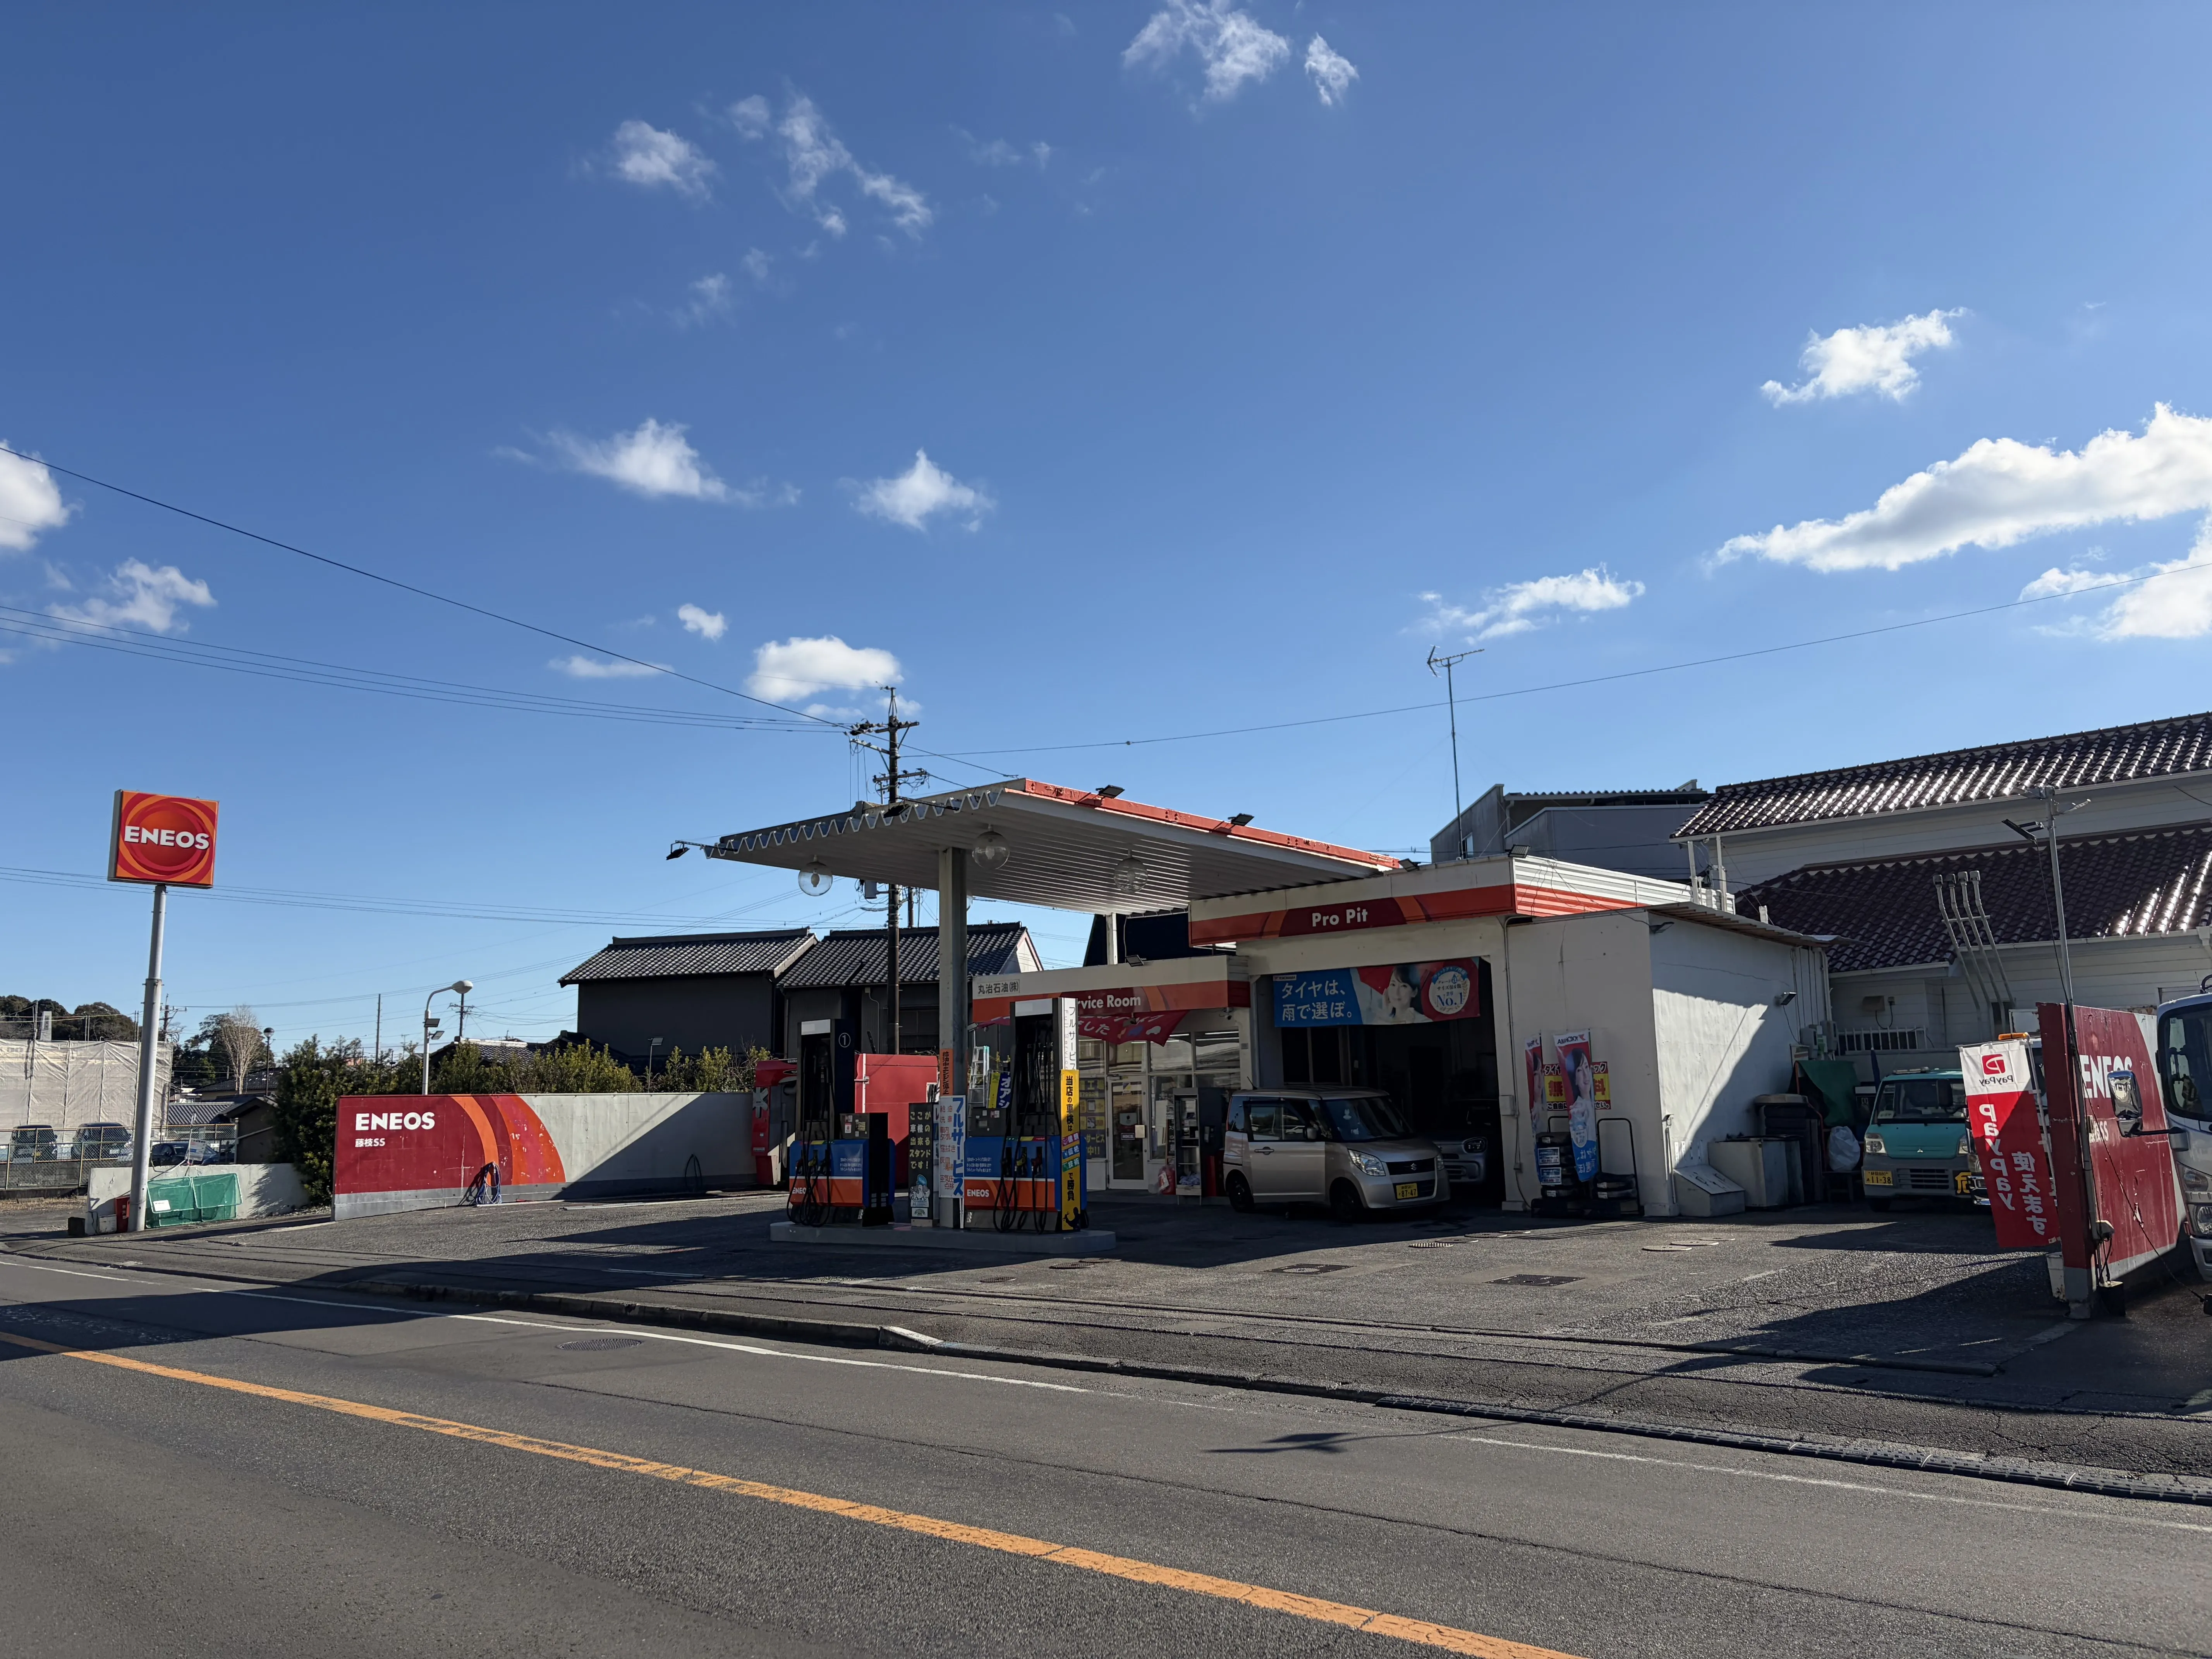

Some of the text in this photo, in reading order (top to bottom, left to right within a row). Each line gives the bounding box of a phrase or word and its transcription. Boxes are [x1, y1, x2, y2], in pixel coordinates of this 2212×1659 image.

[124, 826, 209, 849] ENEOS
[1312, 907, 1368, 927] Pro Pit
[978, 981, 1018, 994] 丸治石油(株)
[1282, 979, 1346, 999] タイヤは、
[1077, 994, 1141, 1009] rvice Room
[1436, 992, 1463, 1007] No.1
[1282, 1001, 1352, 1021] 雨で選ぼ。
[1591, 1062, 1607, 1073] ック
[355, 1112, 435, 1130] ENEOS
[910, 1111, 931, 1120] ここが
[910, 1124, 931, 1133] 車検の
[355, 1138, 385, 1147] 藤枝SS
[910, 1137, 930, 1146] 出来る
[952, 1097, 964, 1196] フルサービス
[910, 1149, 931, 1158] スタンド
[910, 1161, 928, 1170] です!
[967, 1189, 990, 1197] ENEOS
